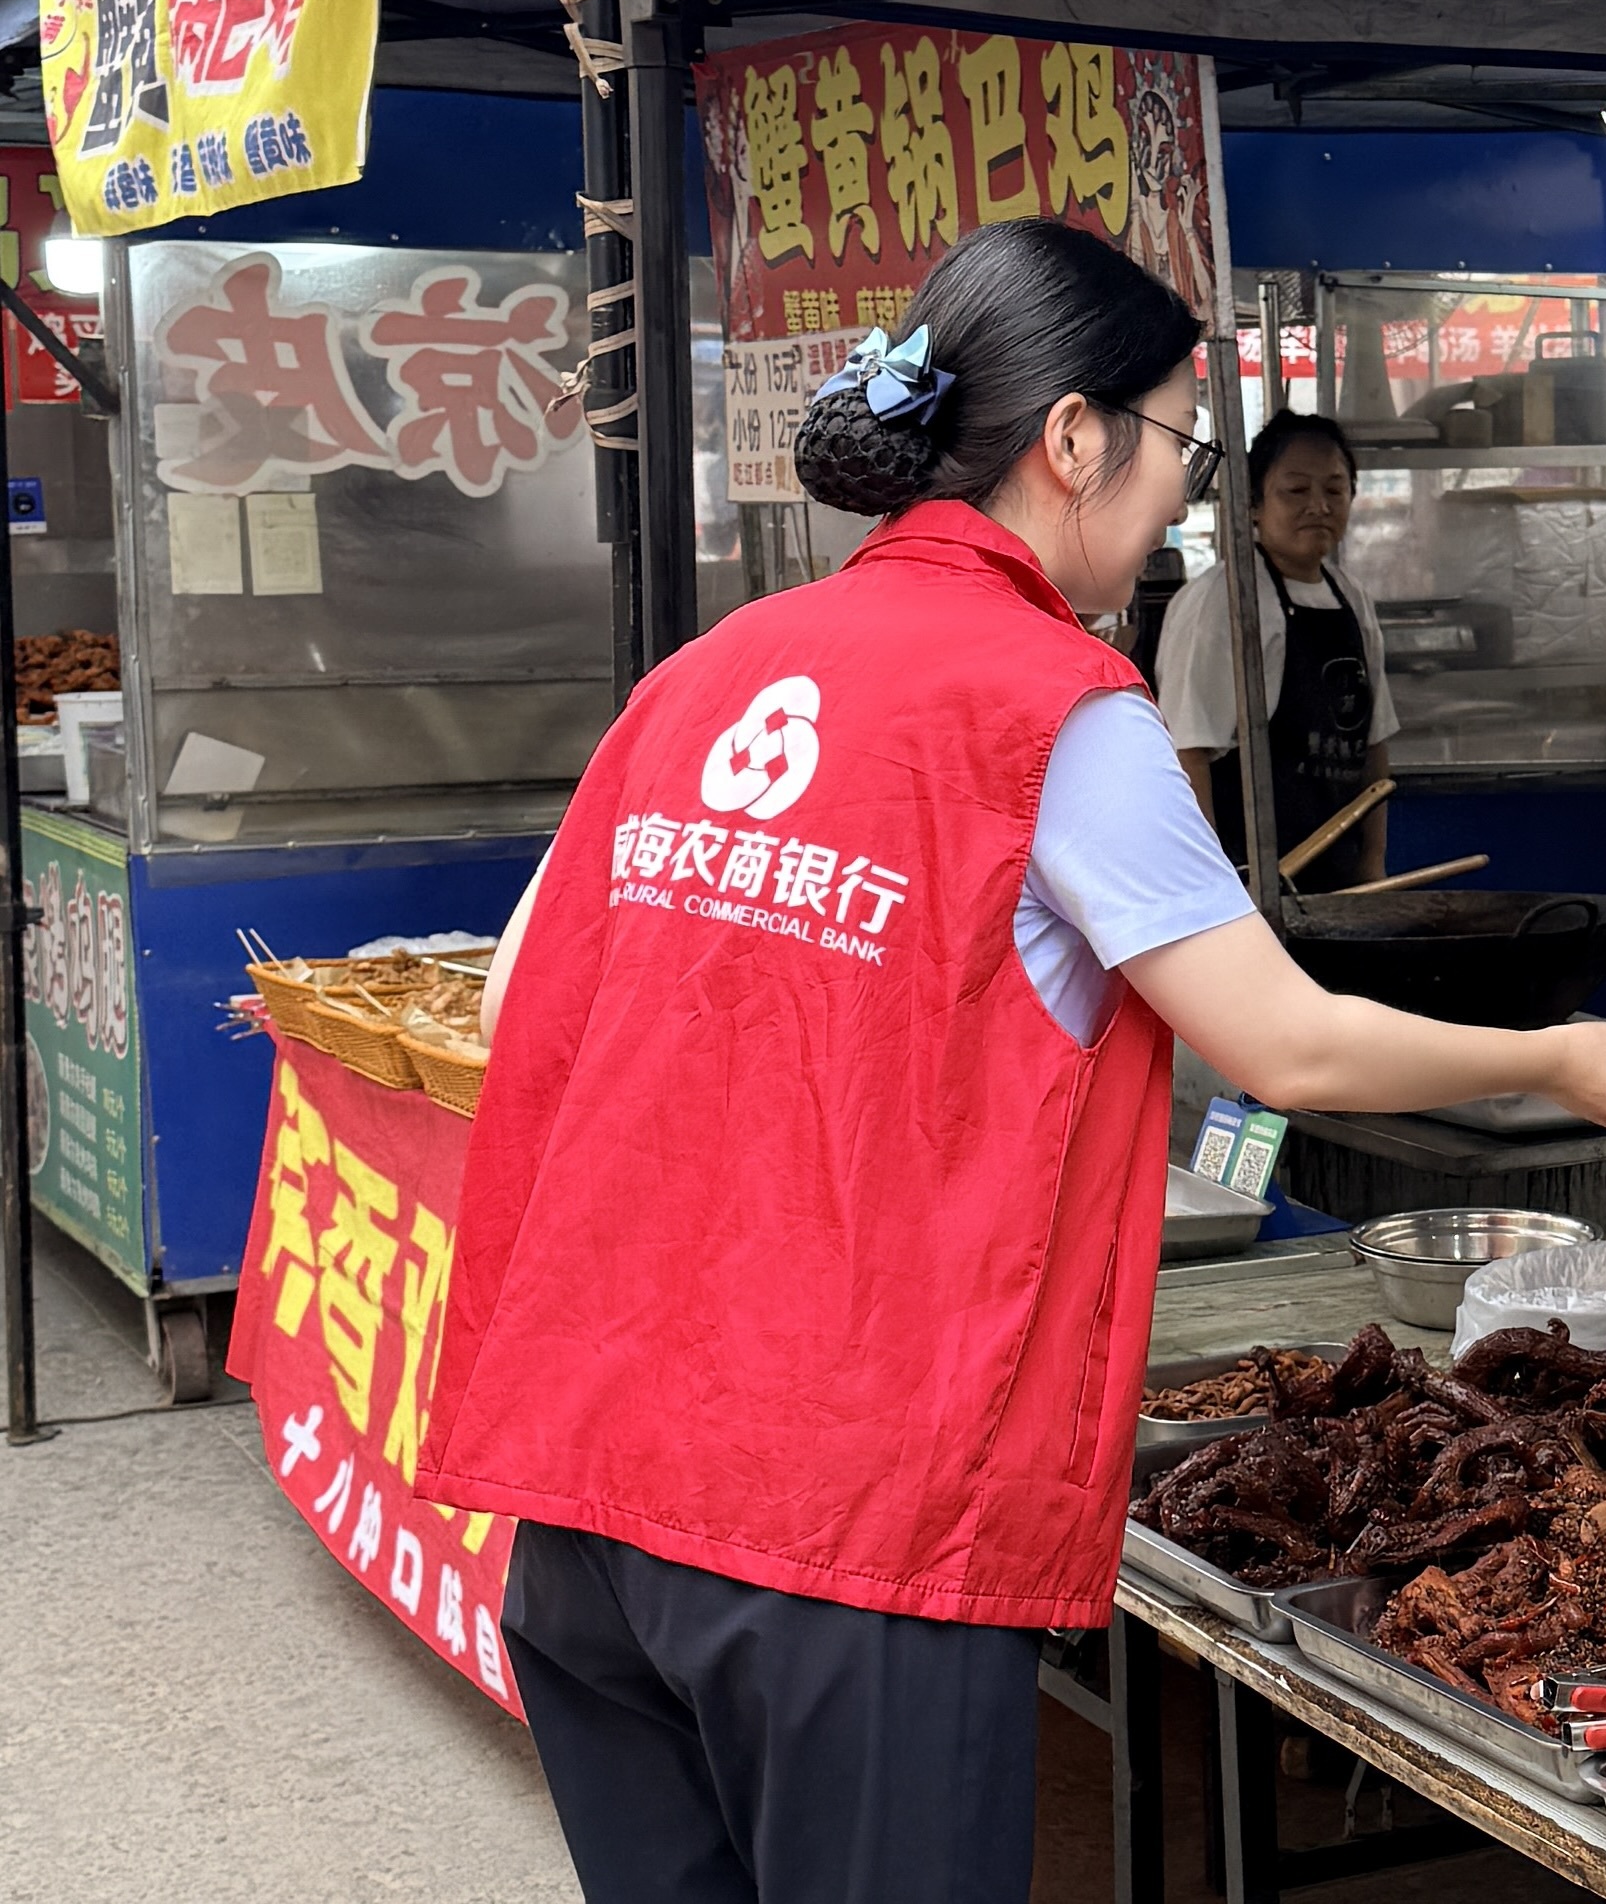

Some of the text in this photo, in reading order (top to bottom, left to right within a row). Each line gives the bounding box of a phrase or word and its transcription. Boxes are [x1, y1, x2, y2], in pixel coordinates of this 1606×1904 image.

[744, 34, 1130, 262] 蟹黄锅巴鸡
[765, 351, 798, 393] 15元
[684, 893, 815, 944] COMMERCIAL
[820, 926, 887, 967] BANK
